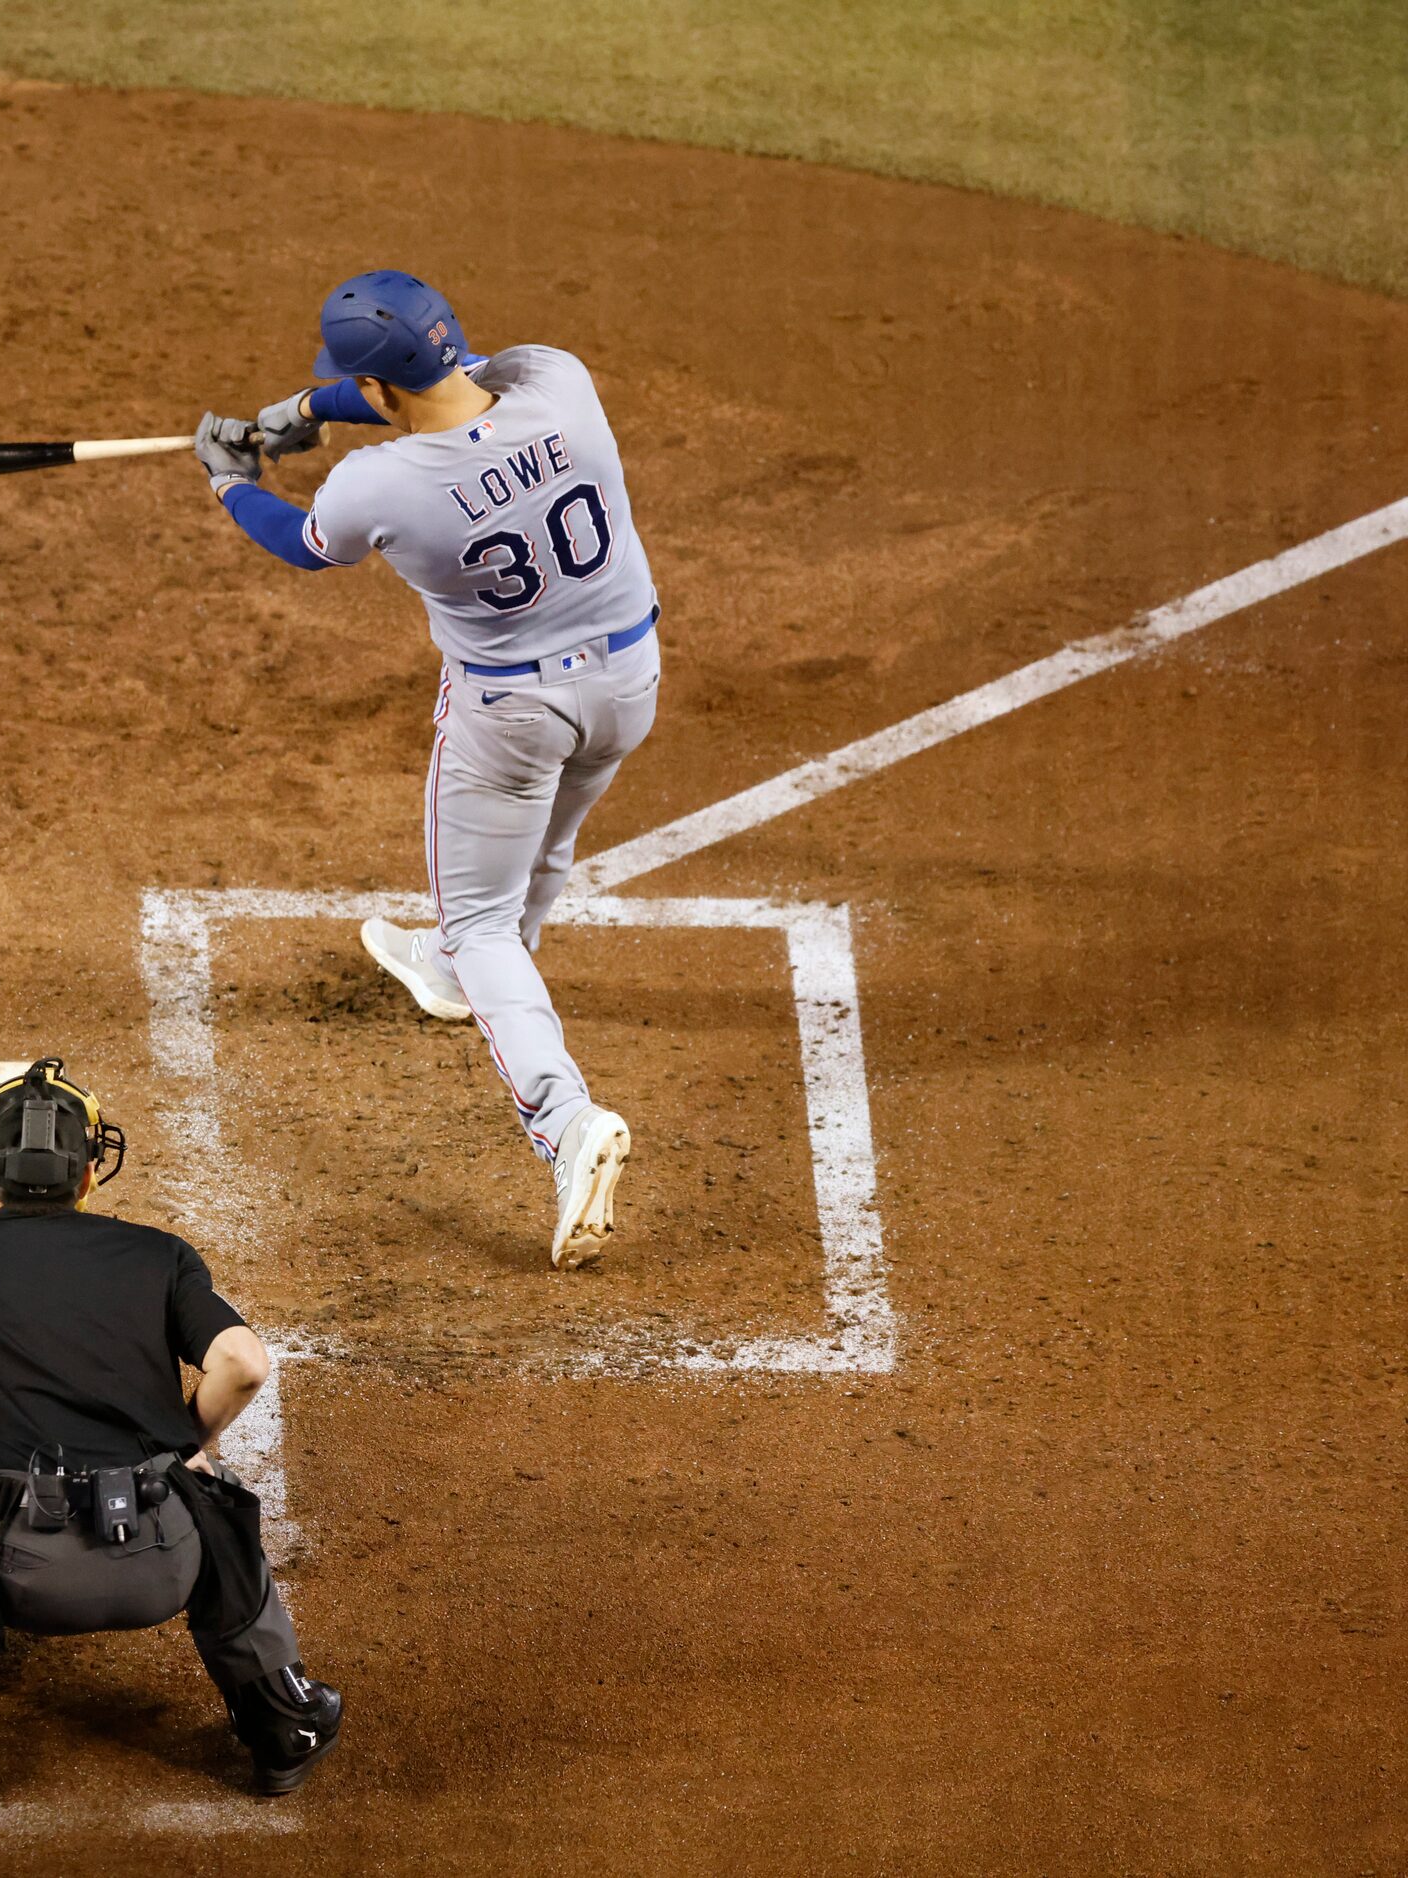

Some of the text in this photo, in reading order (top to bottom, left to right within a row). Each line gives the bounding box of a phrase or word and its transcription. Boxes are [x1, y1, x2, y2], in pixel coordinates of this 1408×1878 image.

[428, 321, 448, 345] 30
[446, 430, 573, 525] LOWE
[458, 480, 614, 614] 30
